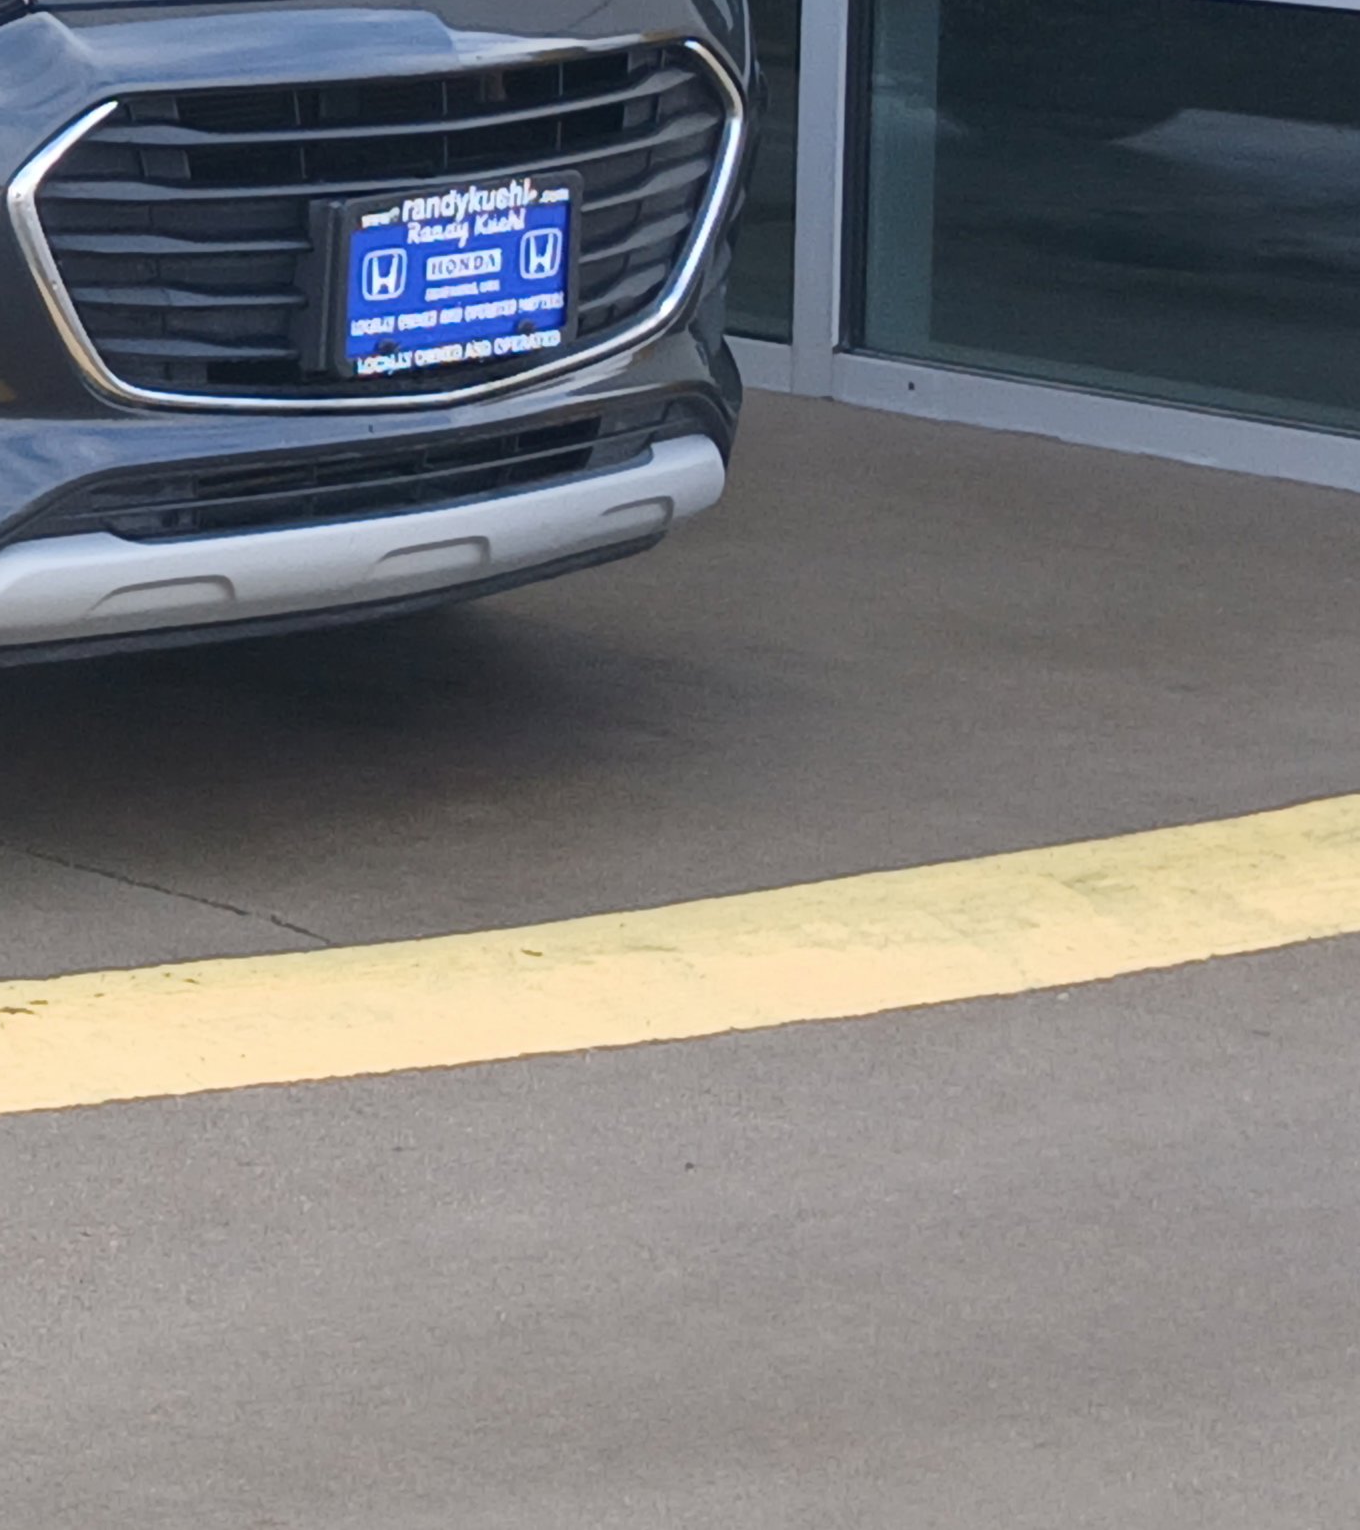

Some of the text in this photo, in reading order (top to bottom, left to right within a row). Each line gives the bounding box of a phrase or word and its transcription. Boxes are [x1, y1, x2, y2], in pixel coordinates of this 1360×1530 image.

[406, 220, 469, 248] Randy
[431, 252, 496, 275] HONDA
[493, 330, 561, 355] OPERATED
